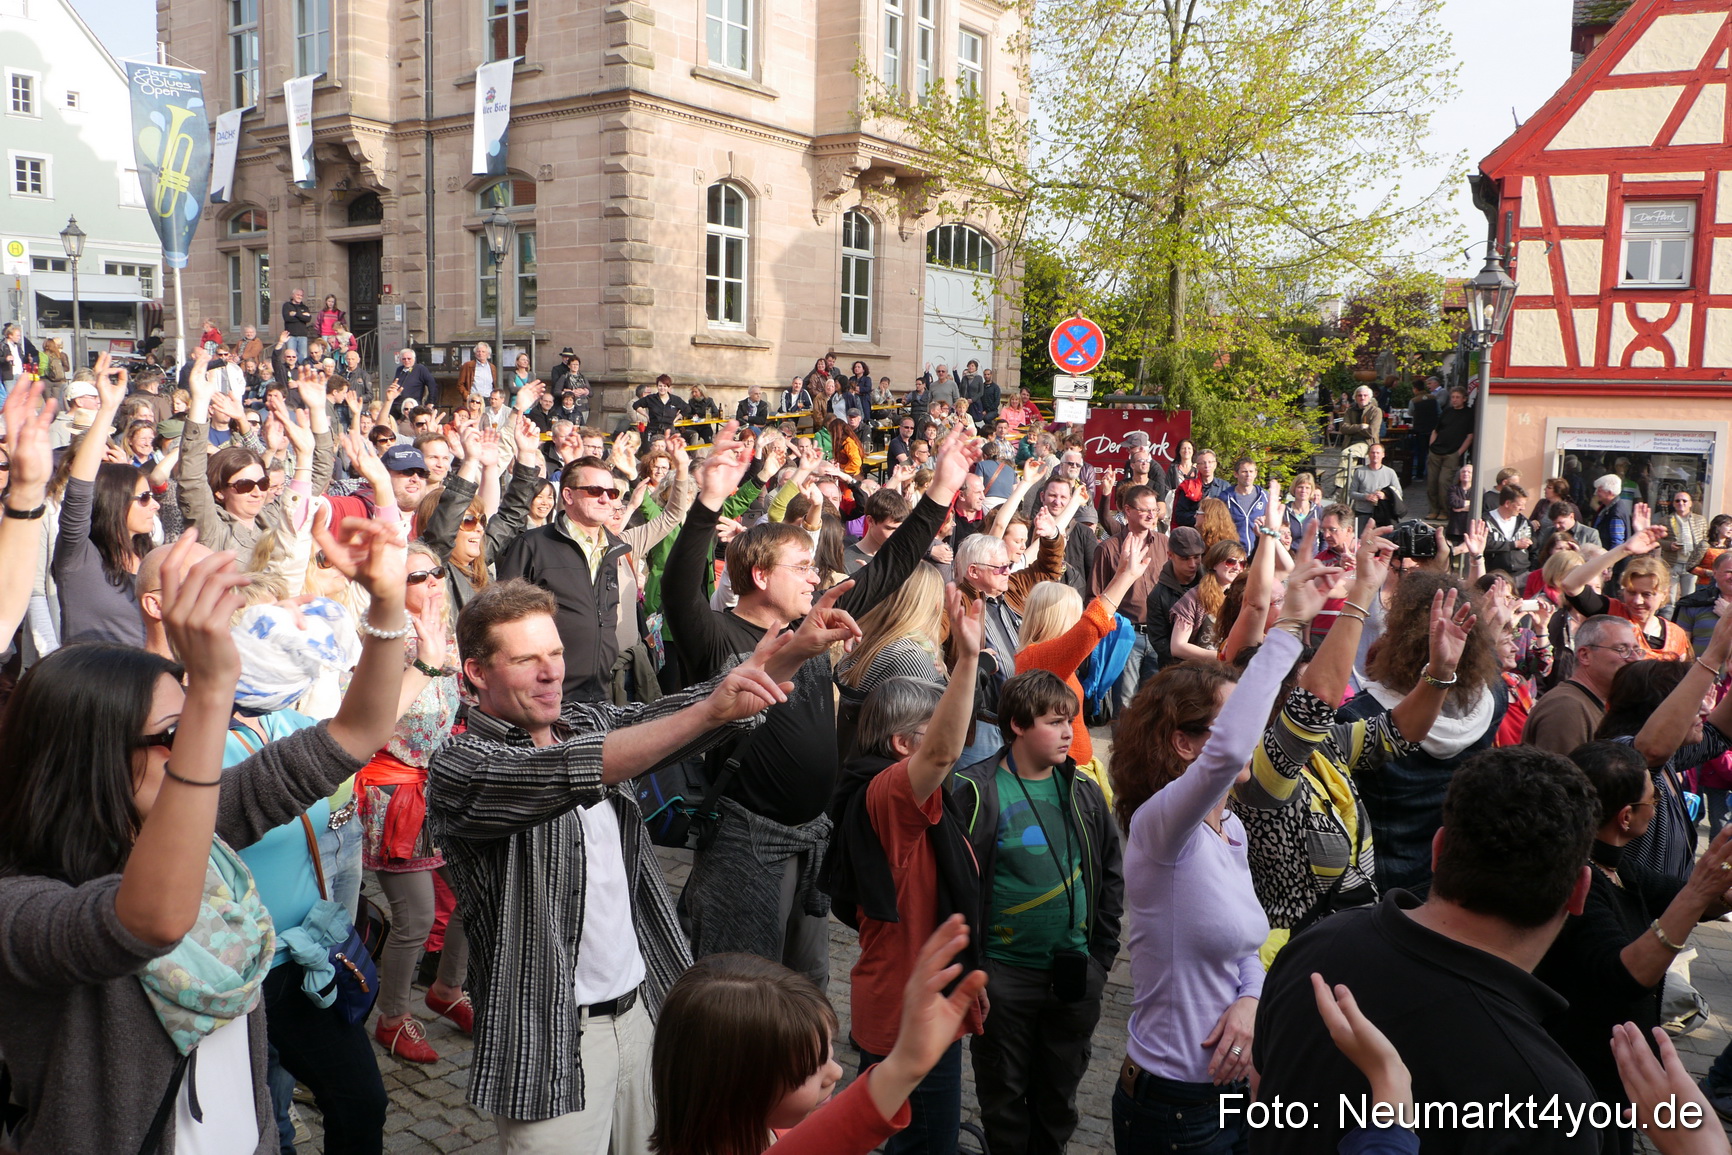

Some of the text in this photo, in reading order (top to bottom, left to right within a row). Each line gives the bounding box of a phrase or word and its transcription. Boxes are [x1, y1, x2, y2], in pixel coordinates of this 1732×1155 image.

[150, 75, 192, 89] Blues
[140, 83, 180, 99] Open
[1517, 412, 1532, 425] 14
[1084, 433, 1122, 455] Der
